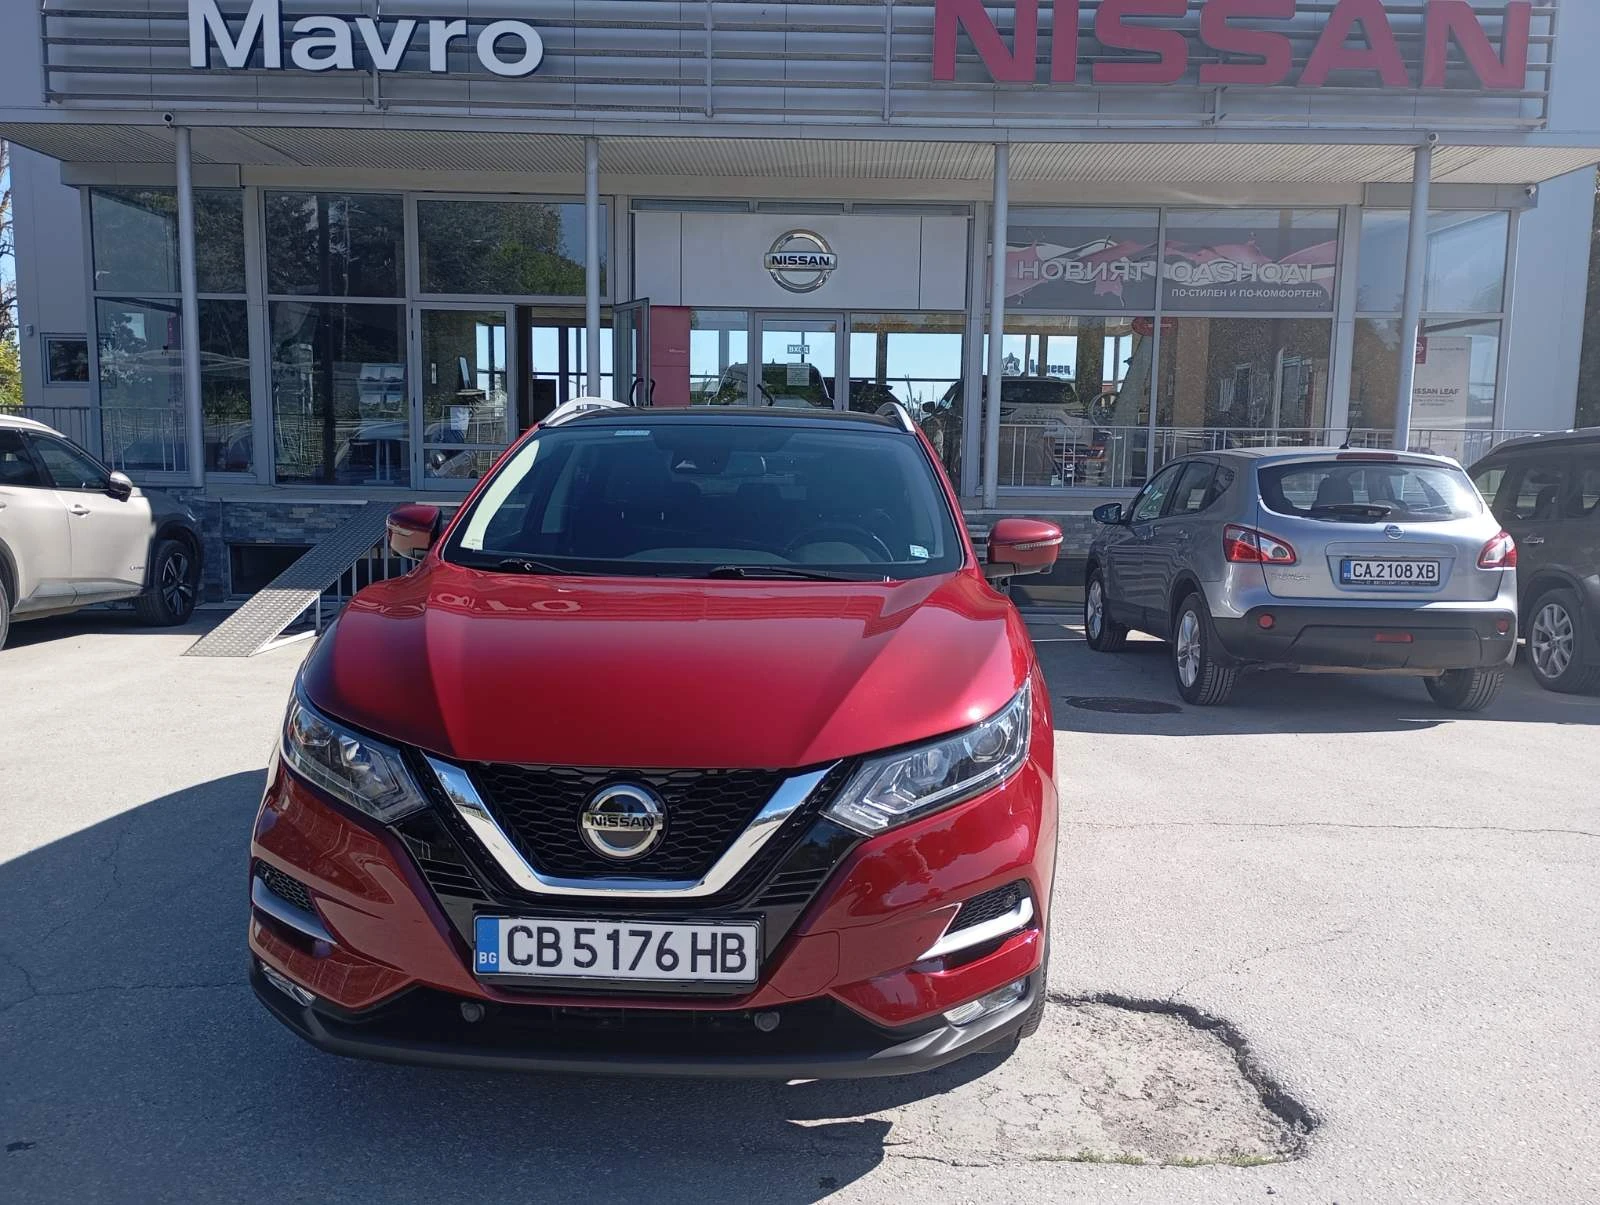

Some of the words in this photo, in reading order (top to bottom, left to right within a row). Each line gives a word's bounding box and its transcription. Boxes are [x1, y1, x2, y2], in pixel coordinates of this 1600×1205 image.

[188, 0, 544, 76] Mavro
[932, 0, 1532, 90] NISSAN
[771, 255, 830, 266] NISSAN
[1018, 260, 1149, 281] НОВИЯТ
[1170, 262, 1312, 284] QASHQAI
[1171, 288, 1227, 297] ПО-СТИЛЕН
[1229, 289, 1237, 298] И
[1239, 289, 1322, 298] ПО-КОМФОРТЕН!
[1376, 563, 1413, 579] 2108
[590, 816, 655, 829] NISSAN
[507, 925, 563, 967] CB
[573, 927, 680, 972] 5176
[690, 931, 747, 974] HB
[478, 951, 498, 965] BG
